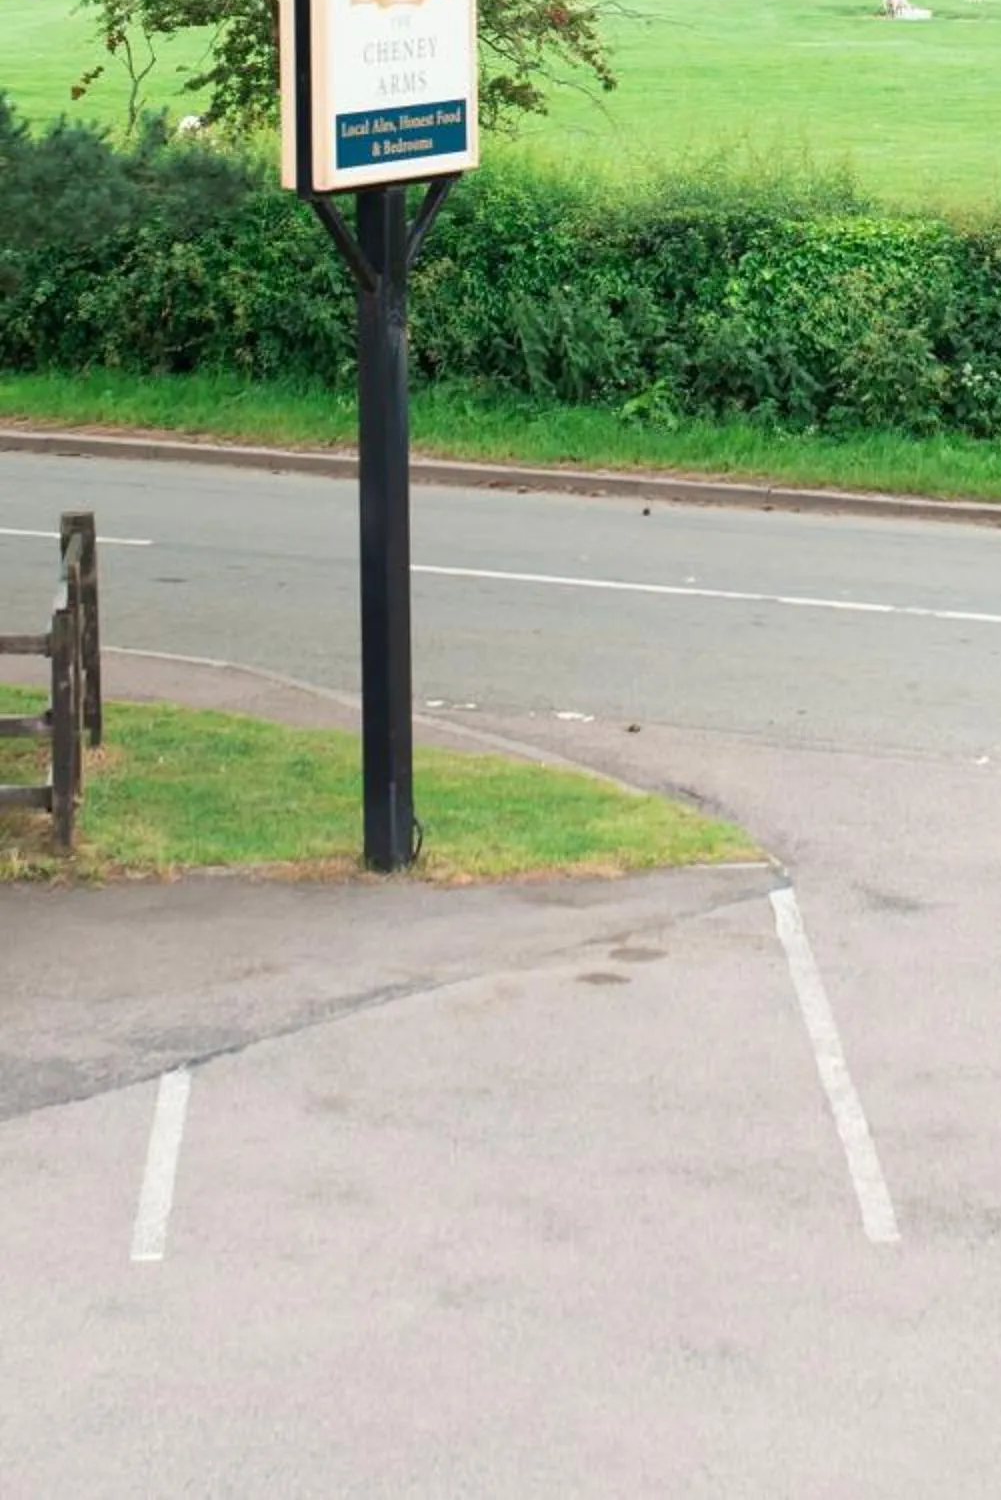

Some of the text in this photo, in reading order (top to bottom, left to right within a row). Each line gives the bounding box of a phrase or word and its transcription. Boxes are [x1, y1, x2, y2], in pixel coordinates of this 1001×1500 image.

[363, 35, 437, 64] CHENEY
[377, 72, 427, 95] ARMS
[341, 107, 461, 137] Local Ales, Honest Food
[372, 137, 433, 157] & Bedrooms
